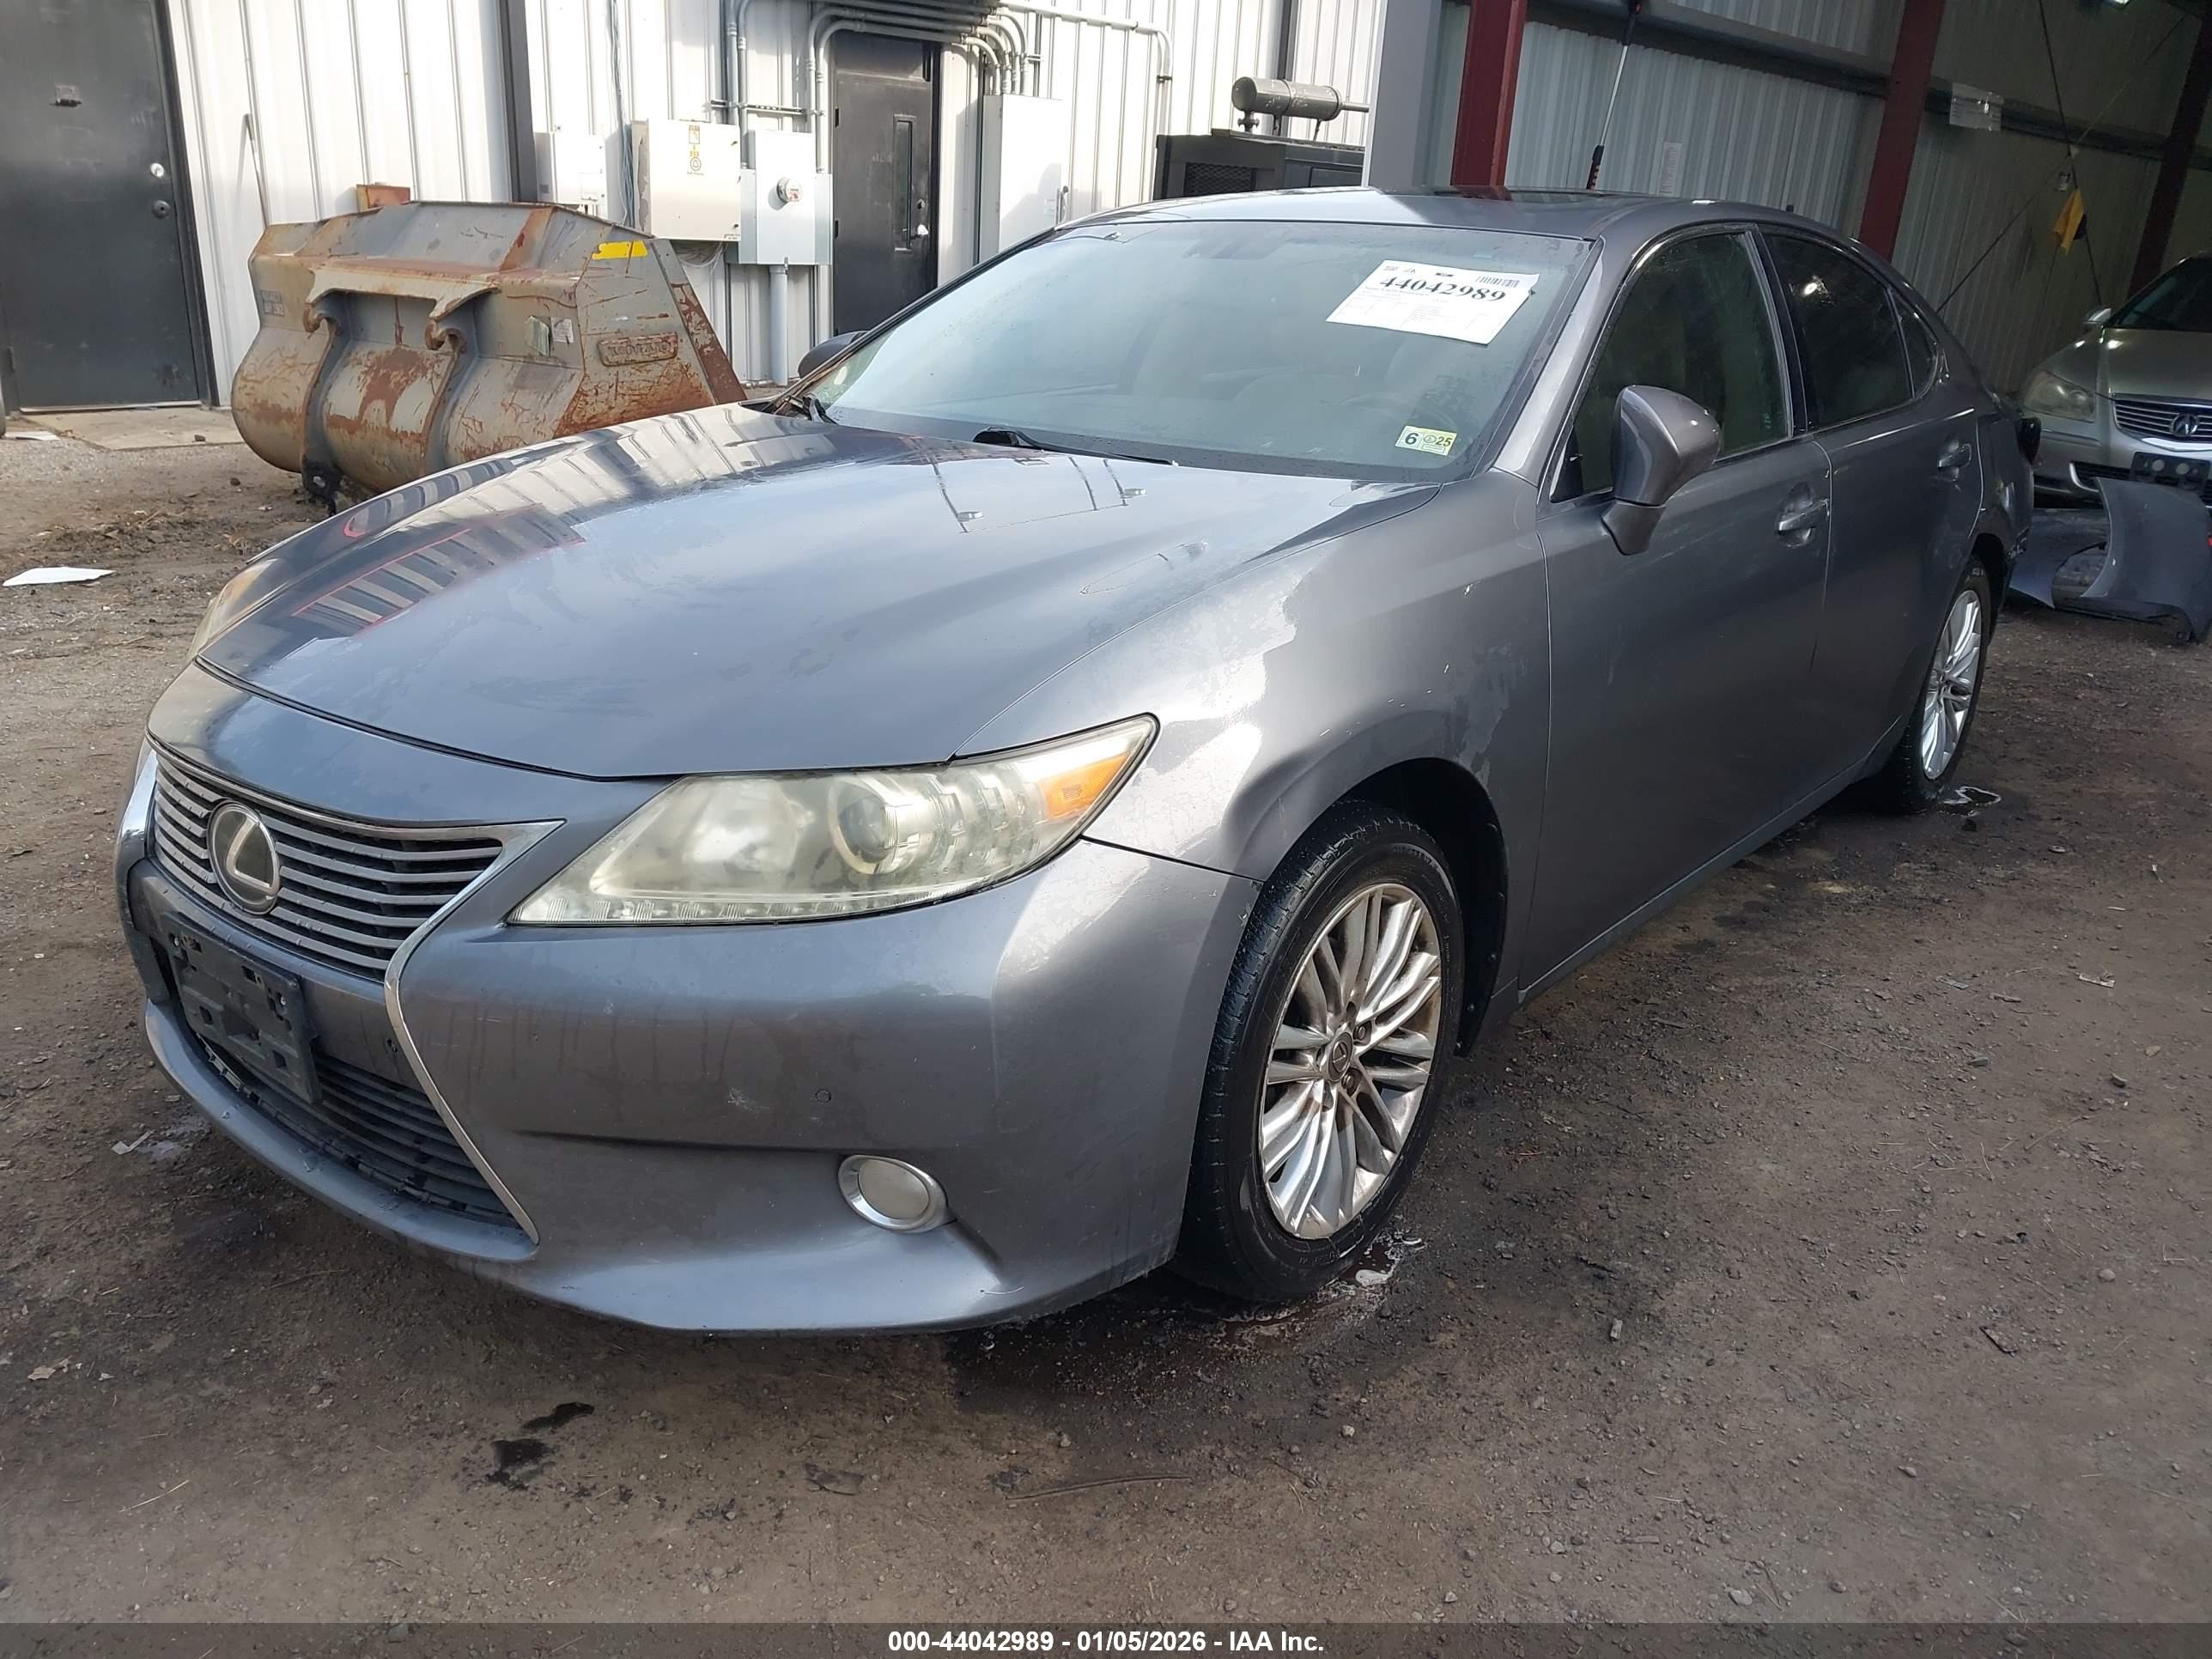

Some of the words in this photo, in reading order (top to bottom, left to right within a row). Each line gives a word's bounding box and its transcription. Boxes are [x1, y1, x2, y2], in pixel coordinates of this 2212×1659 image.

[1380, 276, 1506, 301] 44042989
[1405, 432, 1419, 445] 6
[1435, 436, 1453, 447] 25
